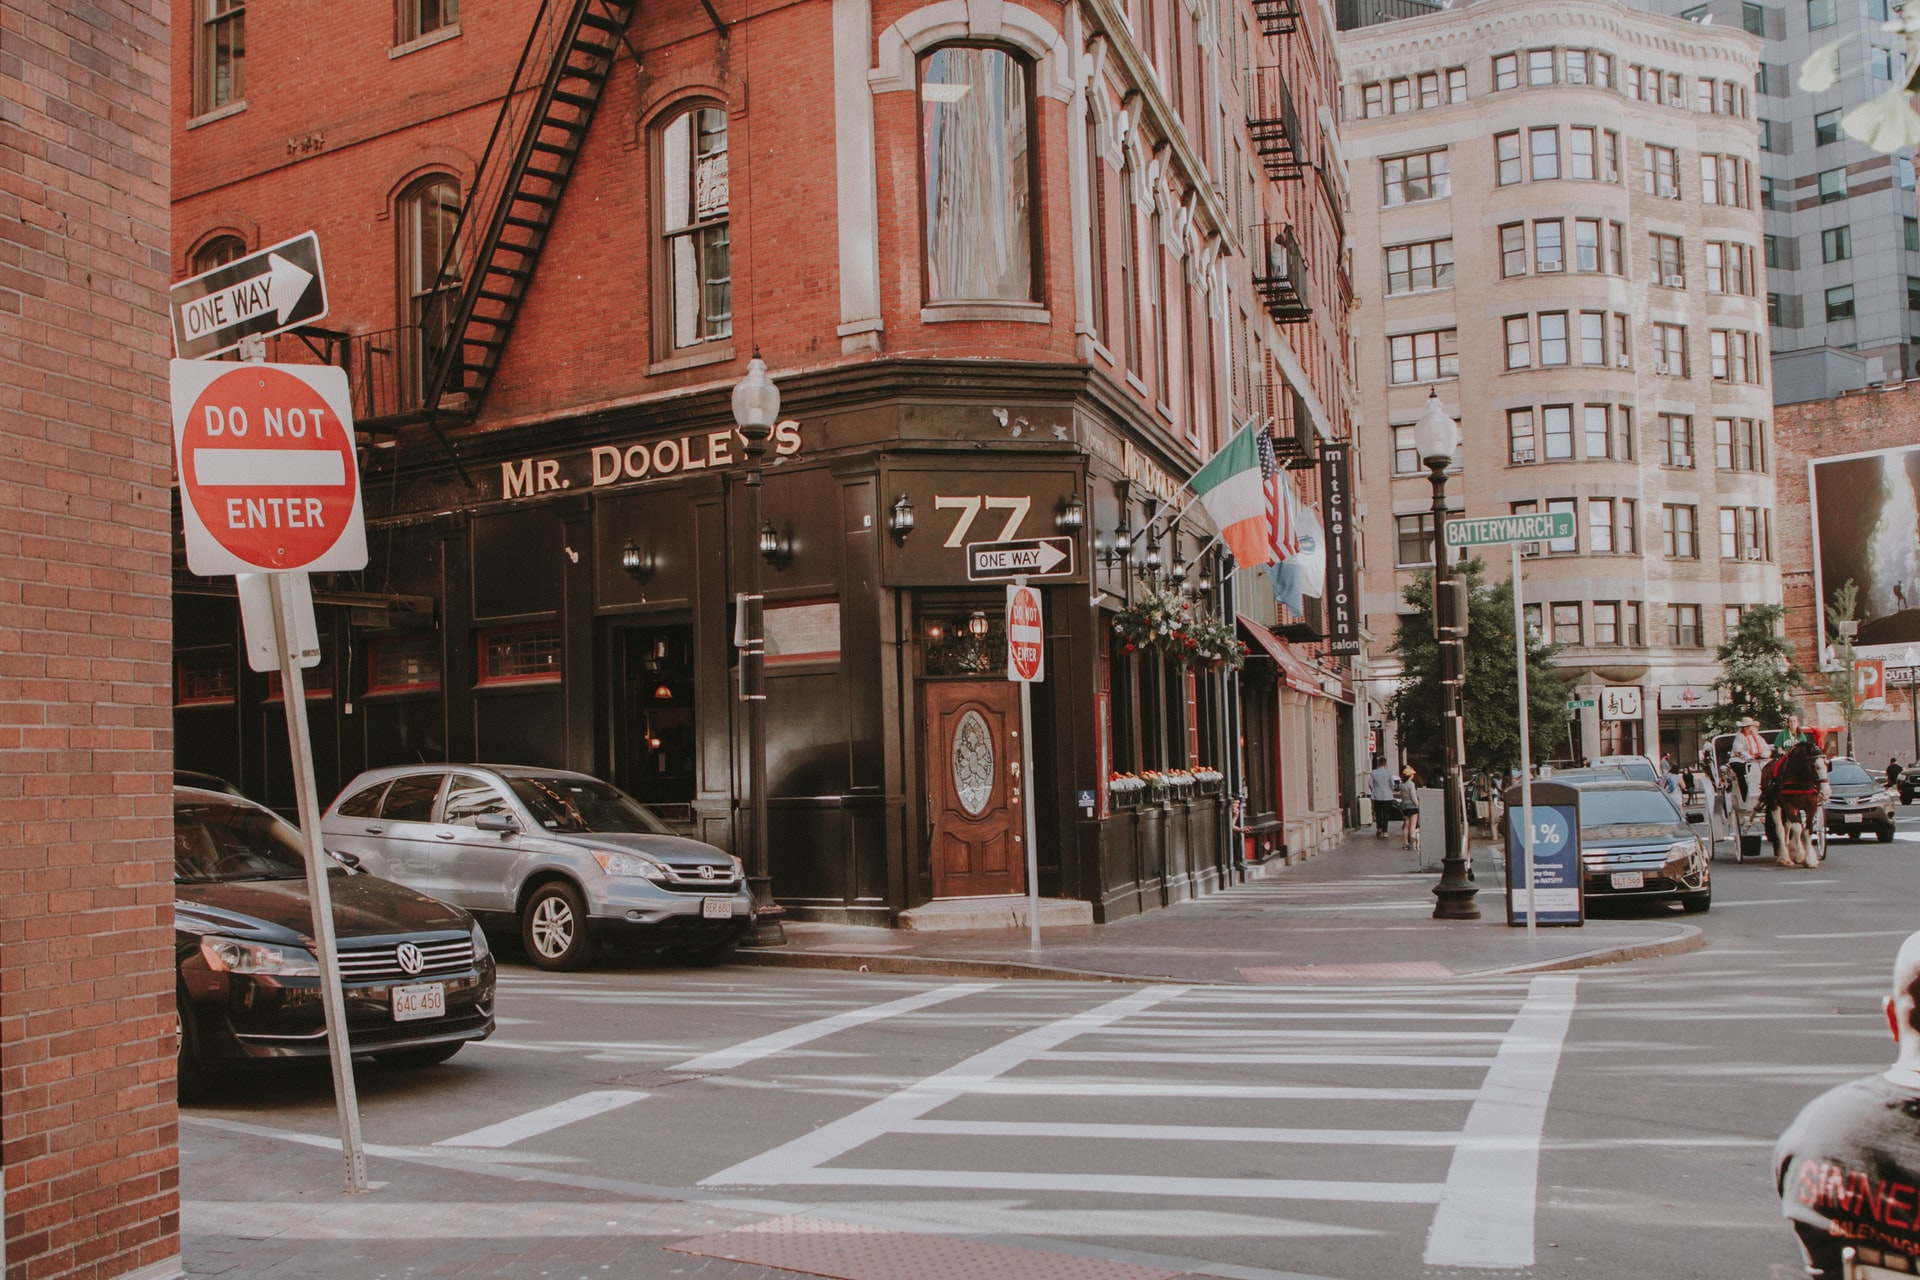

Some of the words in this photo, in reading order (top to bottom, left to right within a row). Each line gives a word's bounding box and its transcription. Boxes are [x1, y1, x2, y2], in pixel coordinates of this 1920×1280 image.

[188, 295, 228, 334] ONE
[232, 276, 272, 318] WAY
[204, 405, 248, 437] DO
[263, 407, 325, 439] NOT
[226, 497, 325, 529] ENTER
[934, 495, 1031, 548] 77
[1448, 516, 1554, 544] BATTERYMARCH
[1559, 523, 1569, 535] ST
[980, 553, 1007, 568] ONE
[1012, 551, 1040, 566] WAY
[1025, 607, 1037, 621] NOT
[1335, 573, 1349, 634] john
[1017, 648, 1037, 662] ENTER
[1331, 639, 1359, 650] salon
[1858, 666, 1878, 694] P
[397, 995, 417, 1012] 64C
[421, 993, 441, 1009] 450
[1799, 1160, 1920, 1232] SINNE
